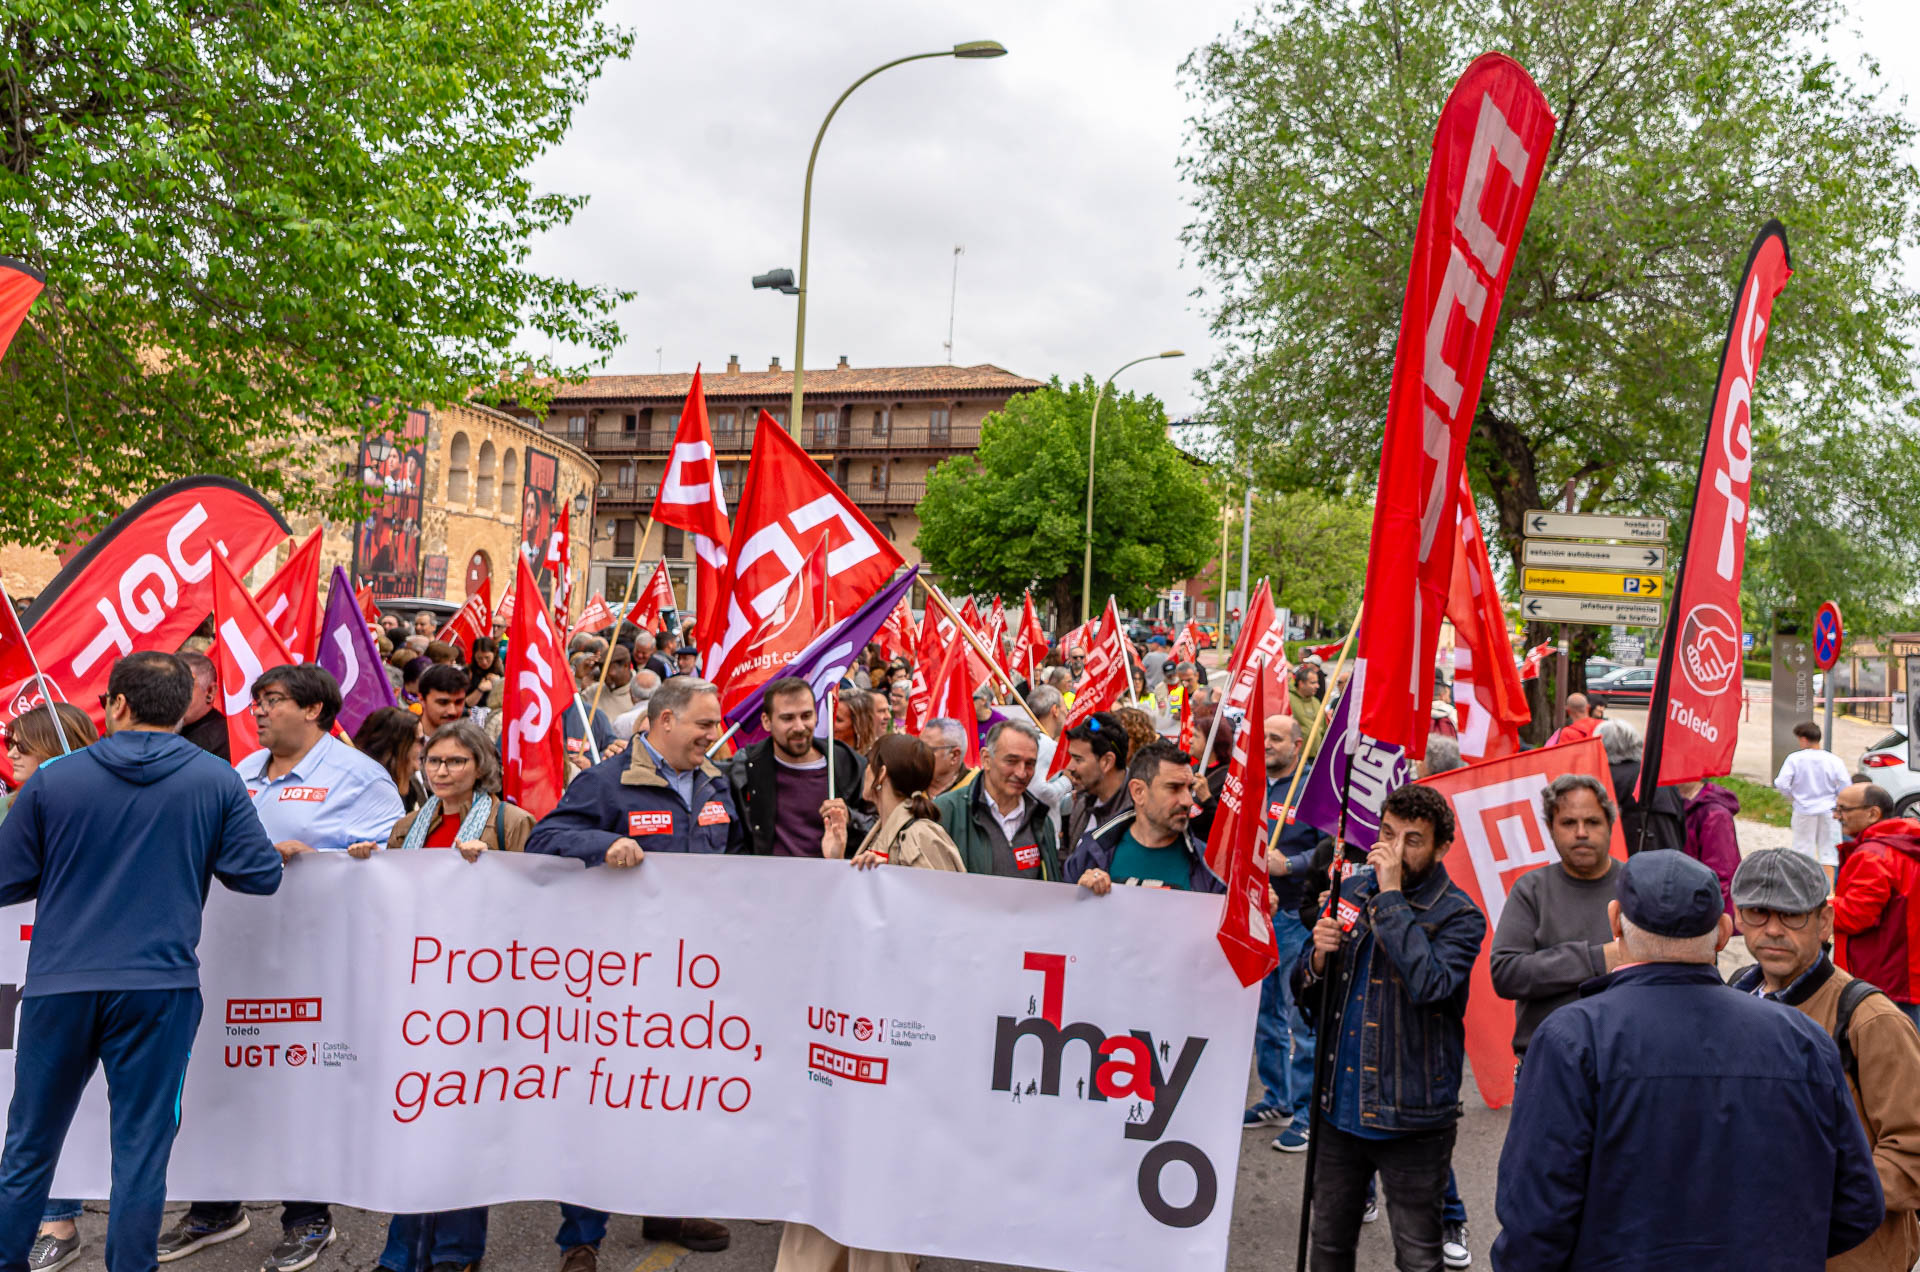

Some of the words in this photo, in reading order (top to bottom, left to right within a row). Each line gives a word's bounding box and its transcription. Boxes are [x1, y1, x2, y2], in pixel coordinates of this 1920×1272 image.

[71, 502, 229, 678] UGT
[1670, 698, 1718, 743] Toledo
[281, 788, 313, 800] UGT
[631, 813, 672, 826] CCOO
[411, 936, 652, 998] Proteger
[677, 938, 721, 989] lo
[230, 1003, 292, 1020] CCOO
[808, 1005, 850, 1037] UGT
[225, 1025, 260, 1036] Toledo
[402, 996, 763, 1062] conquistado,
[891, 1029, 901, 1038] La
[903, 1031, 937, 1042] Mancha
[224, 1044, 281, 1068] UGT
[323, 1052, 332, 1060] La
[334, 1053, 358, 1062] Mancha
[812, 1047, 858, 1077] CCOO
[392, 1063, 571, 1124] ganar
[589, 1056, 753, 1113] futuro
[808, 1070, 834, 1087] Toledo
